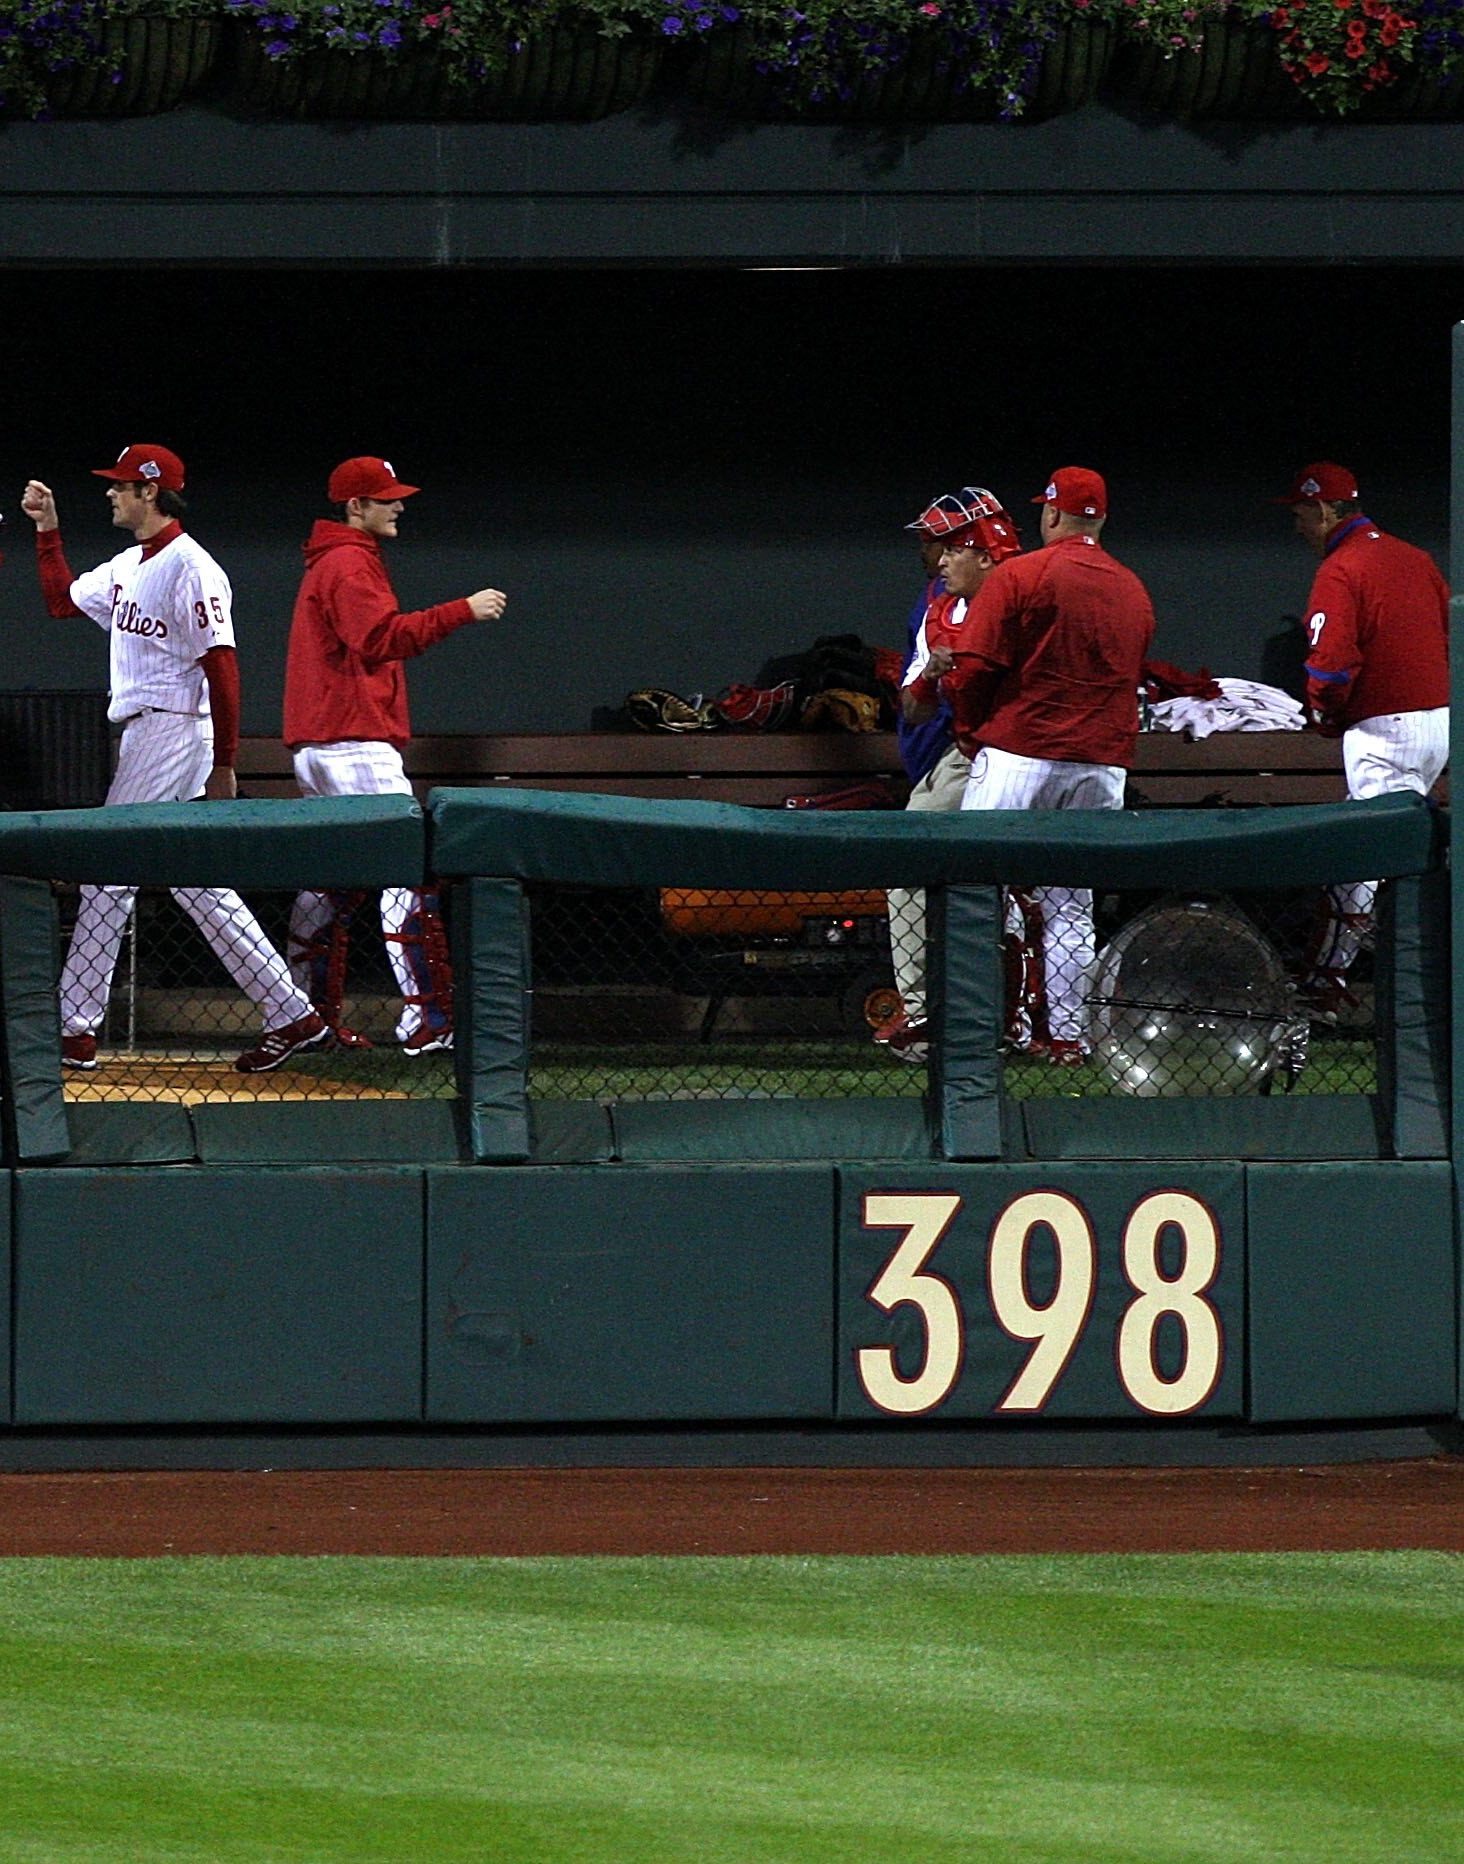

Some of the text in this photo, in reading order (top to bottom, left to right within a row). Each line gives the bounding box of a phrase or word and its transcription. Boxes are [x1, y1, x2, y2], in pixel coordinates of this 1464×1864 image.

[194, 596, 225, 629] 35
[1310, 612, 1326, 646] P
[855, 1187, 1226, 1418] 398
